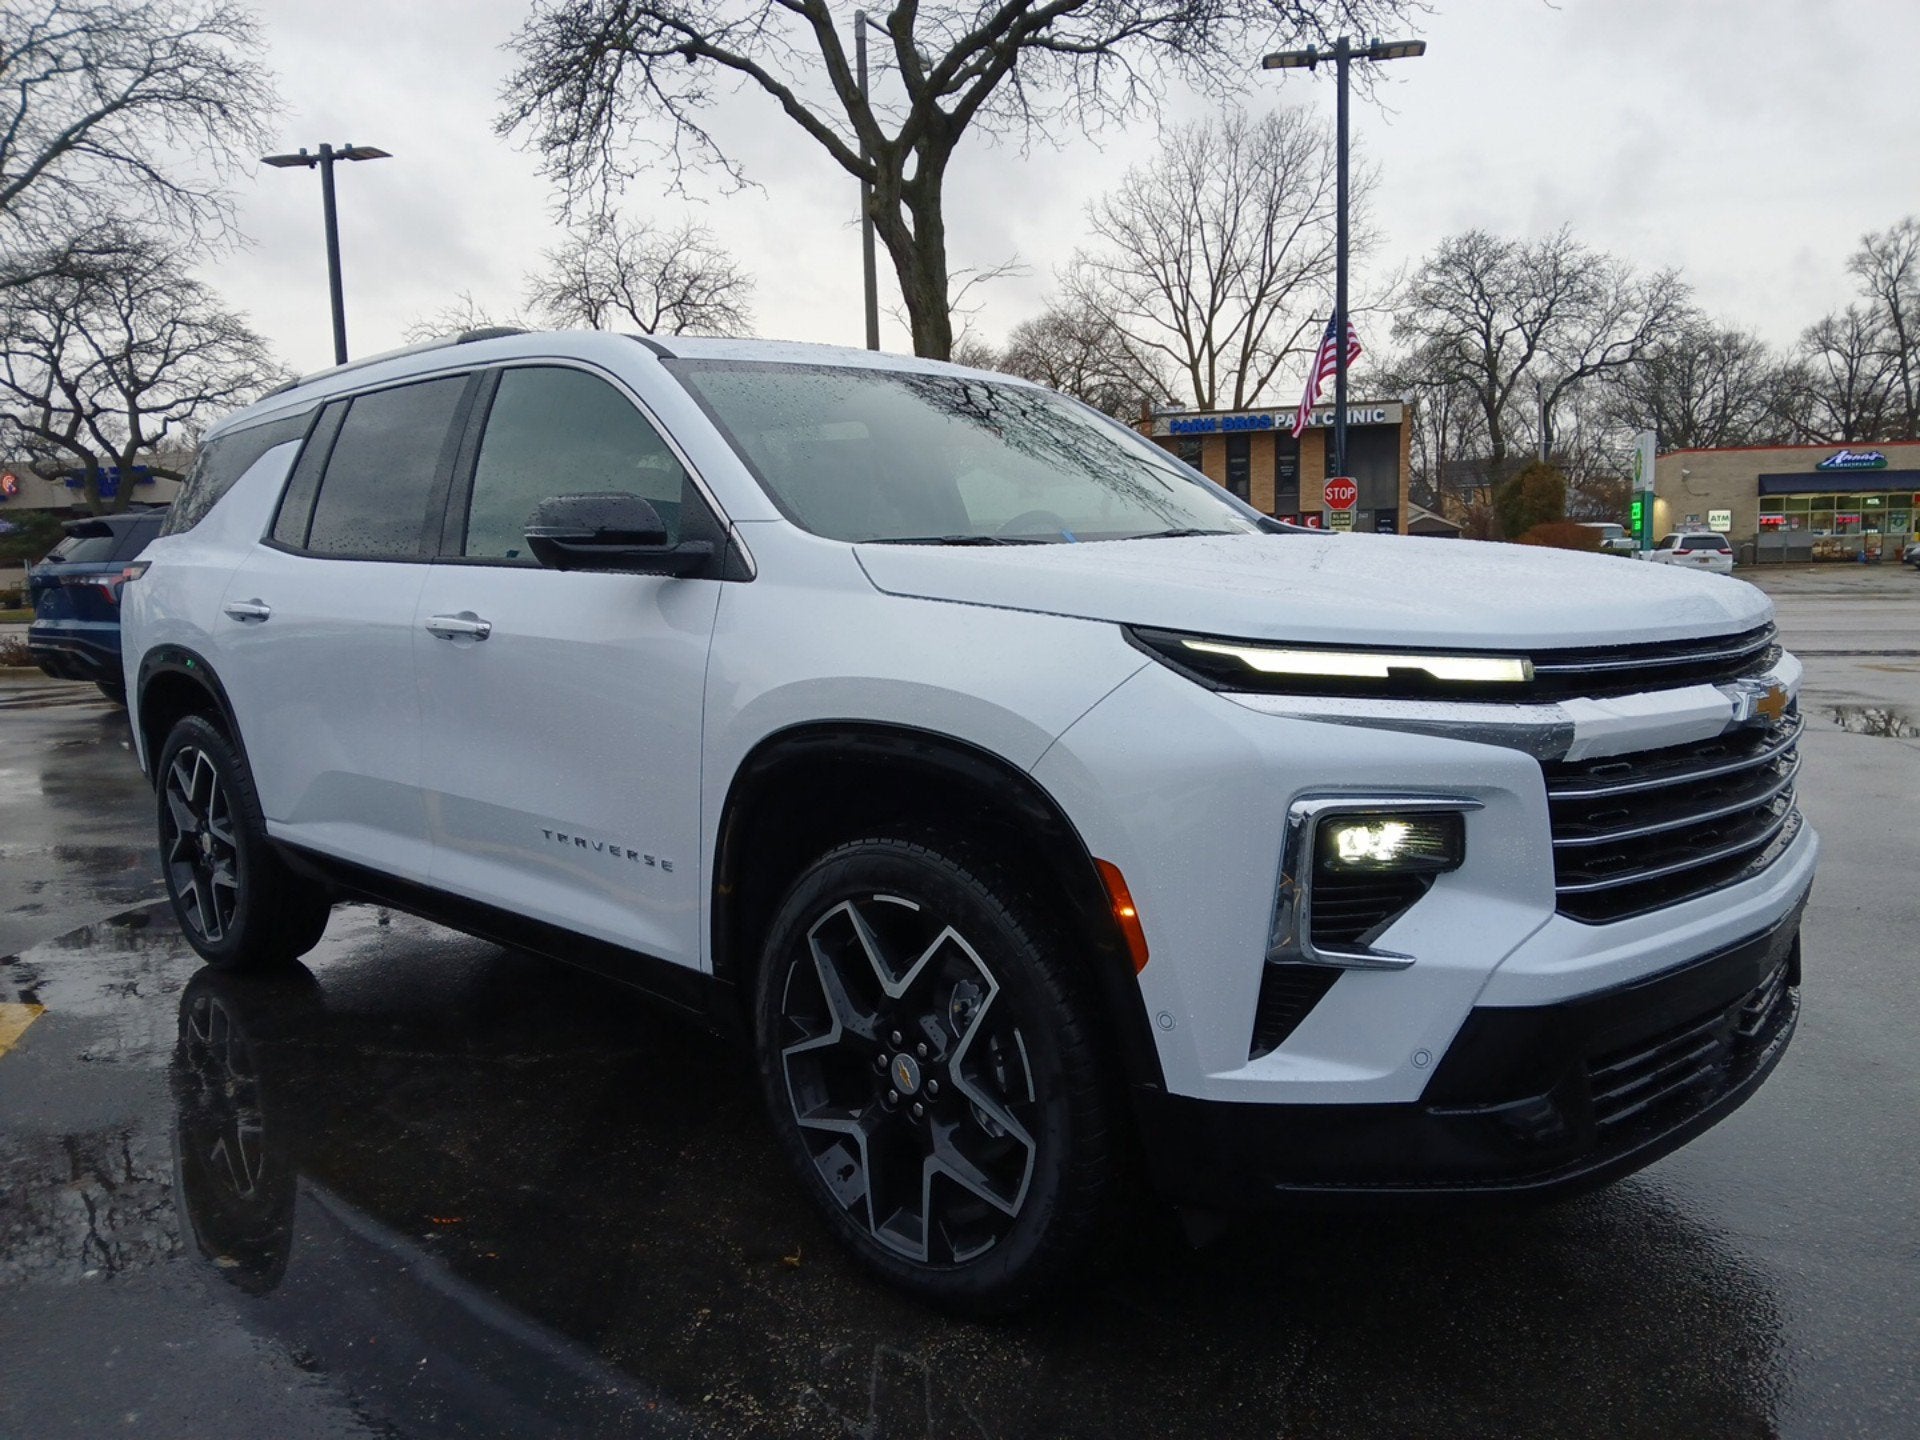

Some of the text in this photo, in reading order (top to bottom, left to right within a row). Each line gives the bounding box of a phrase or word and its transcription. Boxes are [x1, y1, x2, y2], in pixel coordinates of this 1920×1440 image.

[1170, 408, 1385, 434] PARK BROS PAN CINIC
[1326, 487, 1355, 500] STOP
[541, 829, 674, 873] TRAVERSE
